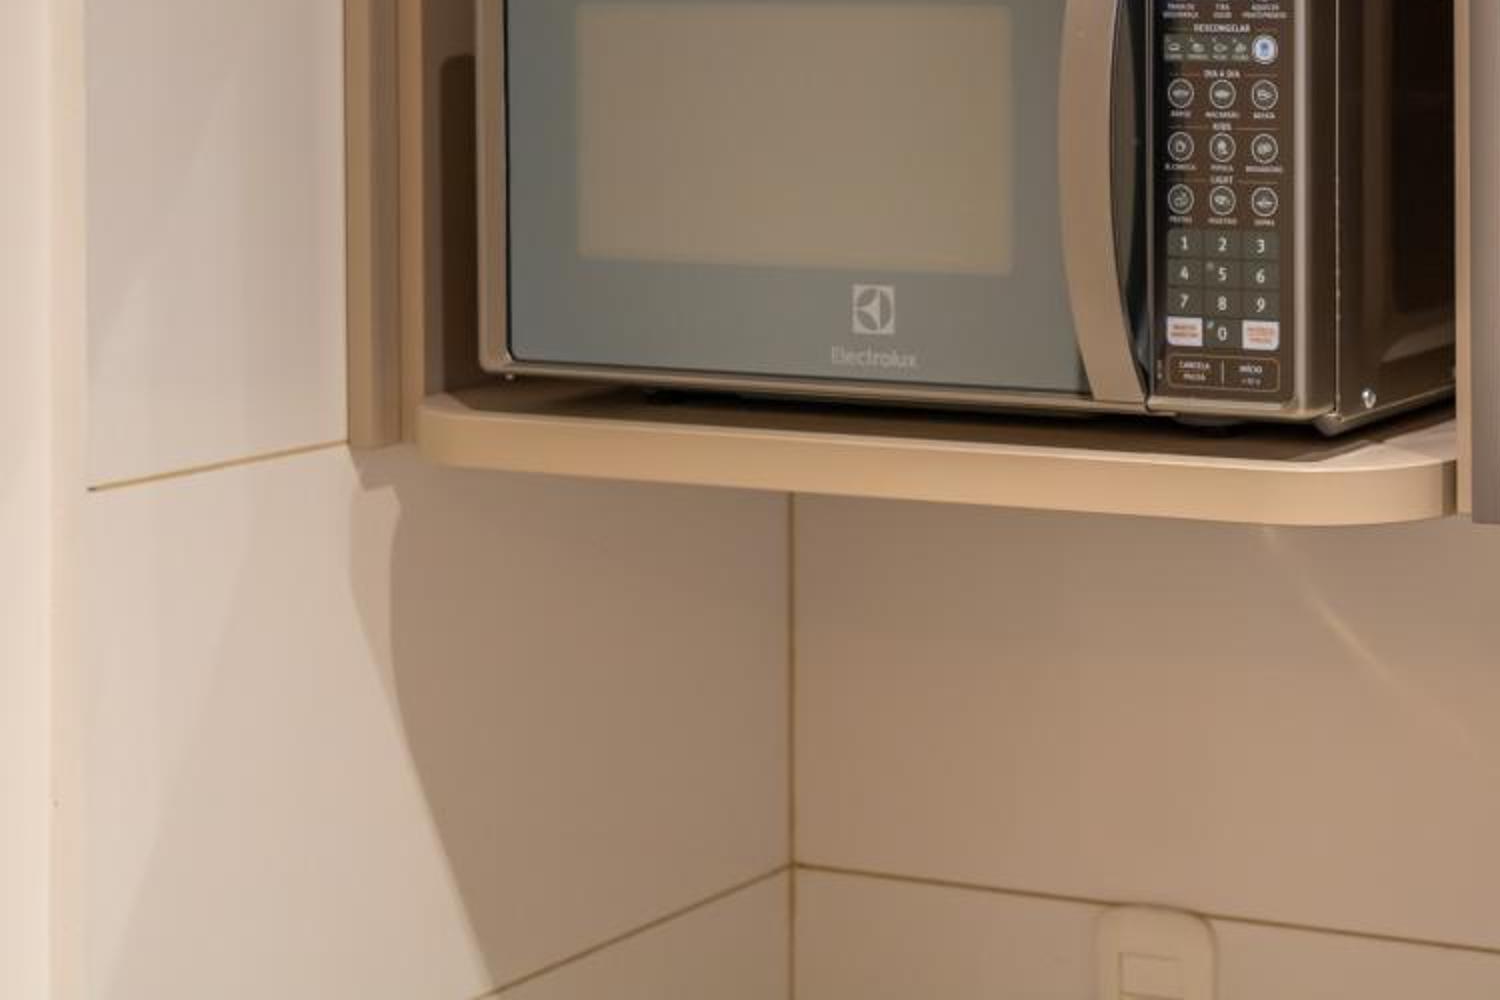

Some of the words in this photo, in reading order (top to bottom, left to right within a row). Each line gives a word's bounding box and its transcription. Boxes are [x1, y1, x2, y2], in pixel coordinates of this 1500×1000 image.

[1180, 236, 1188, 250] 1
[1217, 237, 1227, 251] 2
[1256, 239, 1265, 253] 3
[1180, 266, 1189, 280] 4
[1218, 267, 1227, 281] 5
[1256, 269, 1265, 283] 6
[1180, 294, 1189, 309] 7
[1217, 296, 1227, 311] 8
[1256, 297, 1266, 312] 9
[1217, 326, 1227, 341] 0
[832, 345, 918, 369] Electrolux
